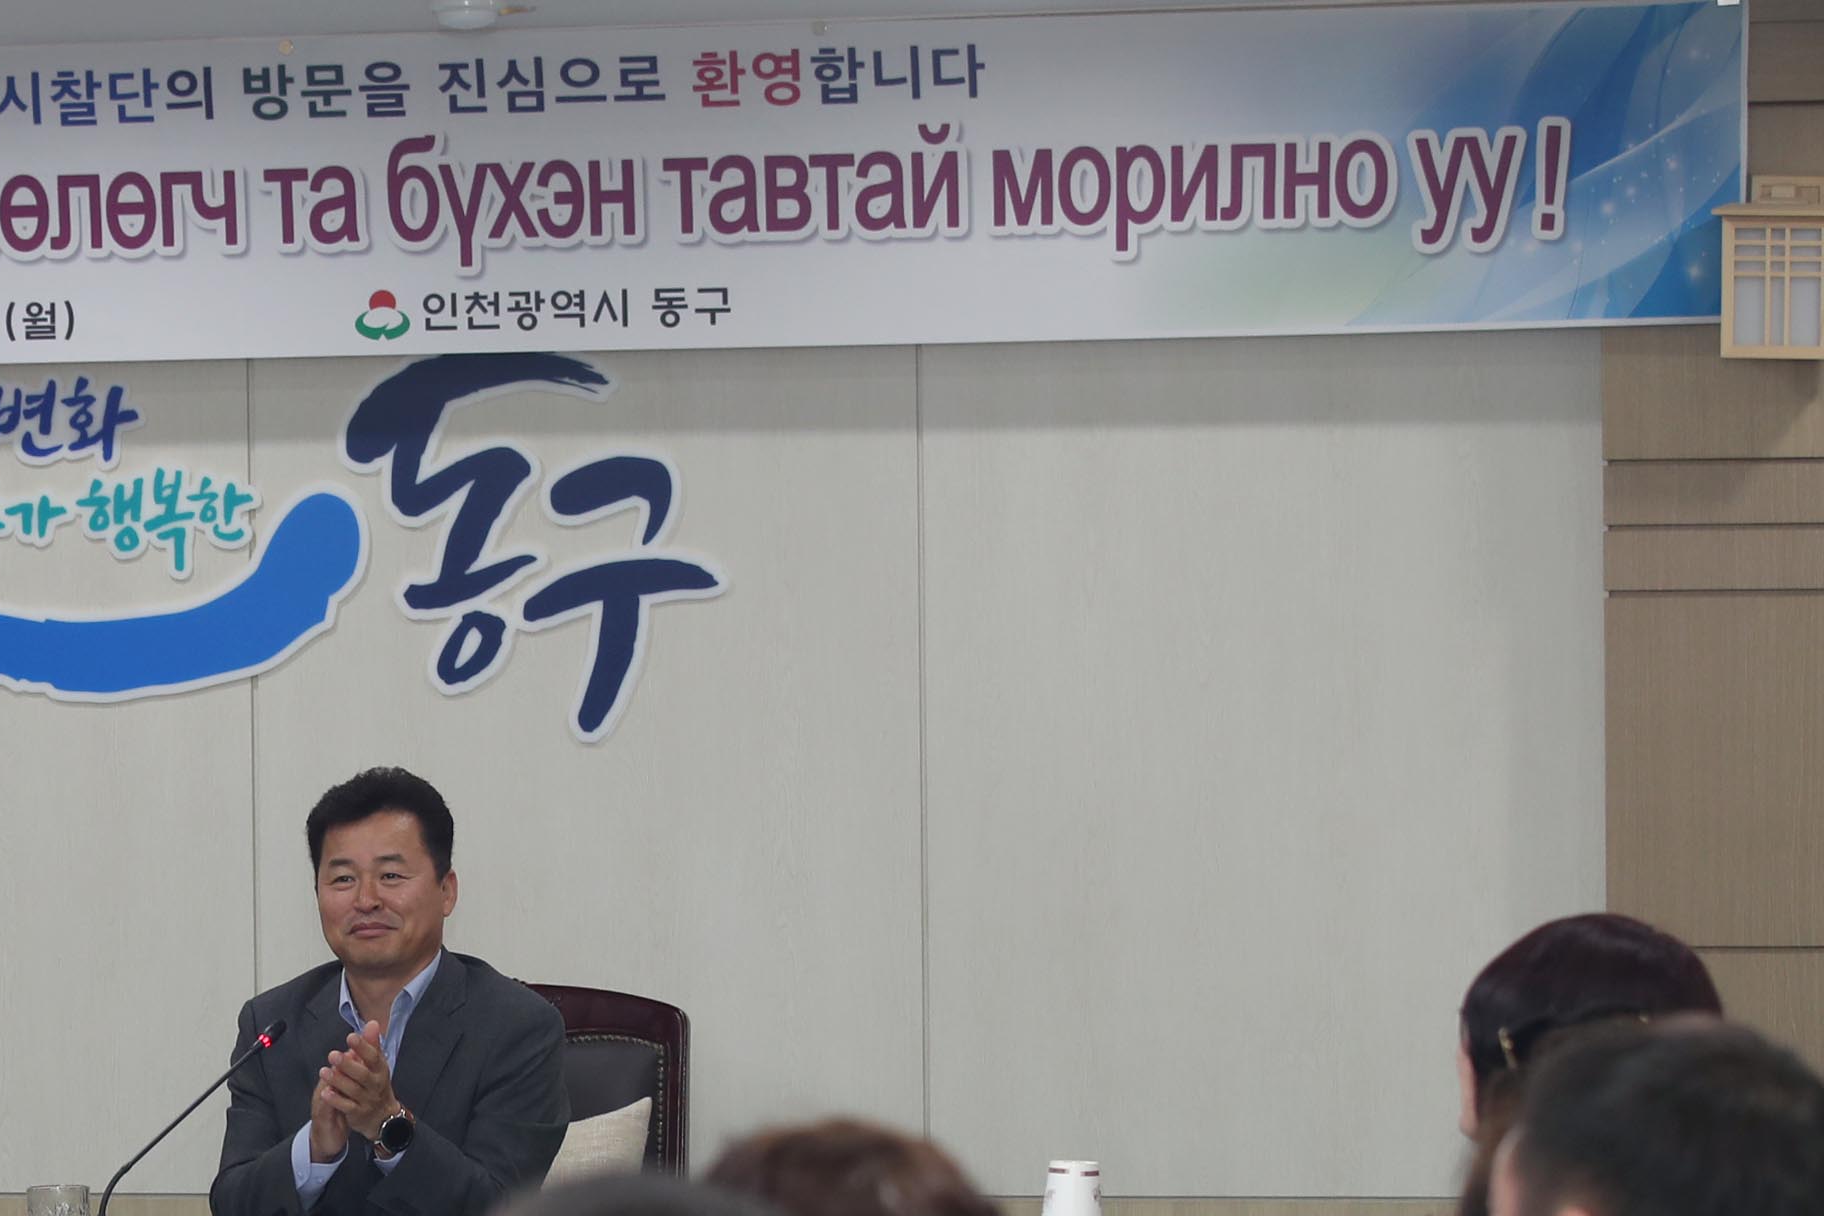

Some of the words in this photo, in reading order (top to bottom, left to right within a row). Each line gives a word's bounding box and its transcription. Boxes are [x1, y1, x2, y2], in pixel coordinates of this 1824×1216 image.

[242, 61, 410, 121] 방문을
[437, 55, 666, 114] 진심으로
[691, 44, 985, 108] 환영합니다
[263, 165, 360, 245] та
[386, 134, 636, 268] бүхэн
[662, 123, 960, 235] тавтай
[992, 138, 1389, 252] морилно
[422, 288, 629, 331] 인천광역시
[651, 287, 732, 328] 동구
[76, 467, 254, 573] 행복한
[346, 352, 720, 733] 동구
